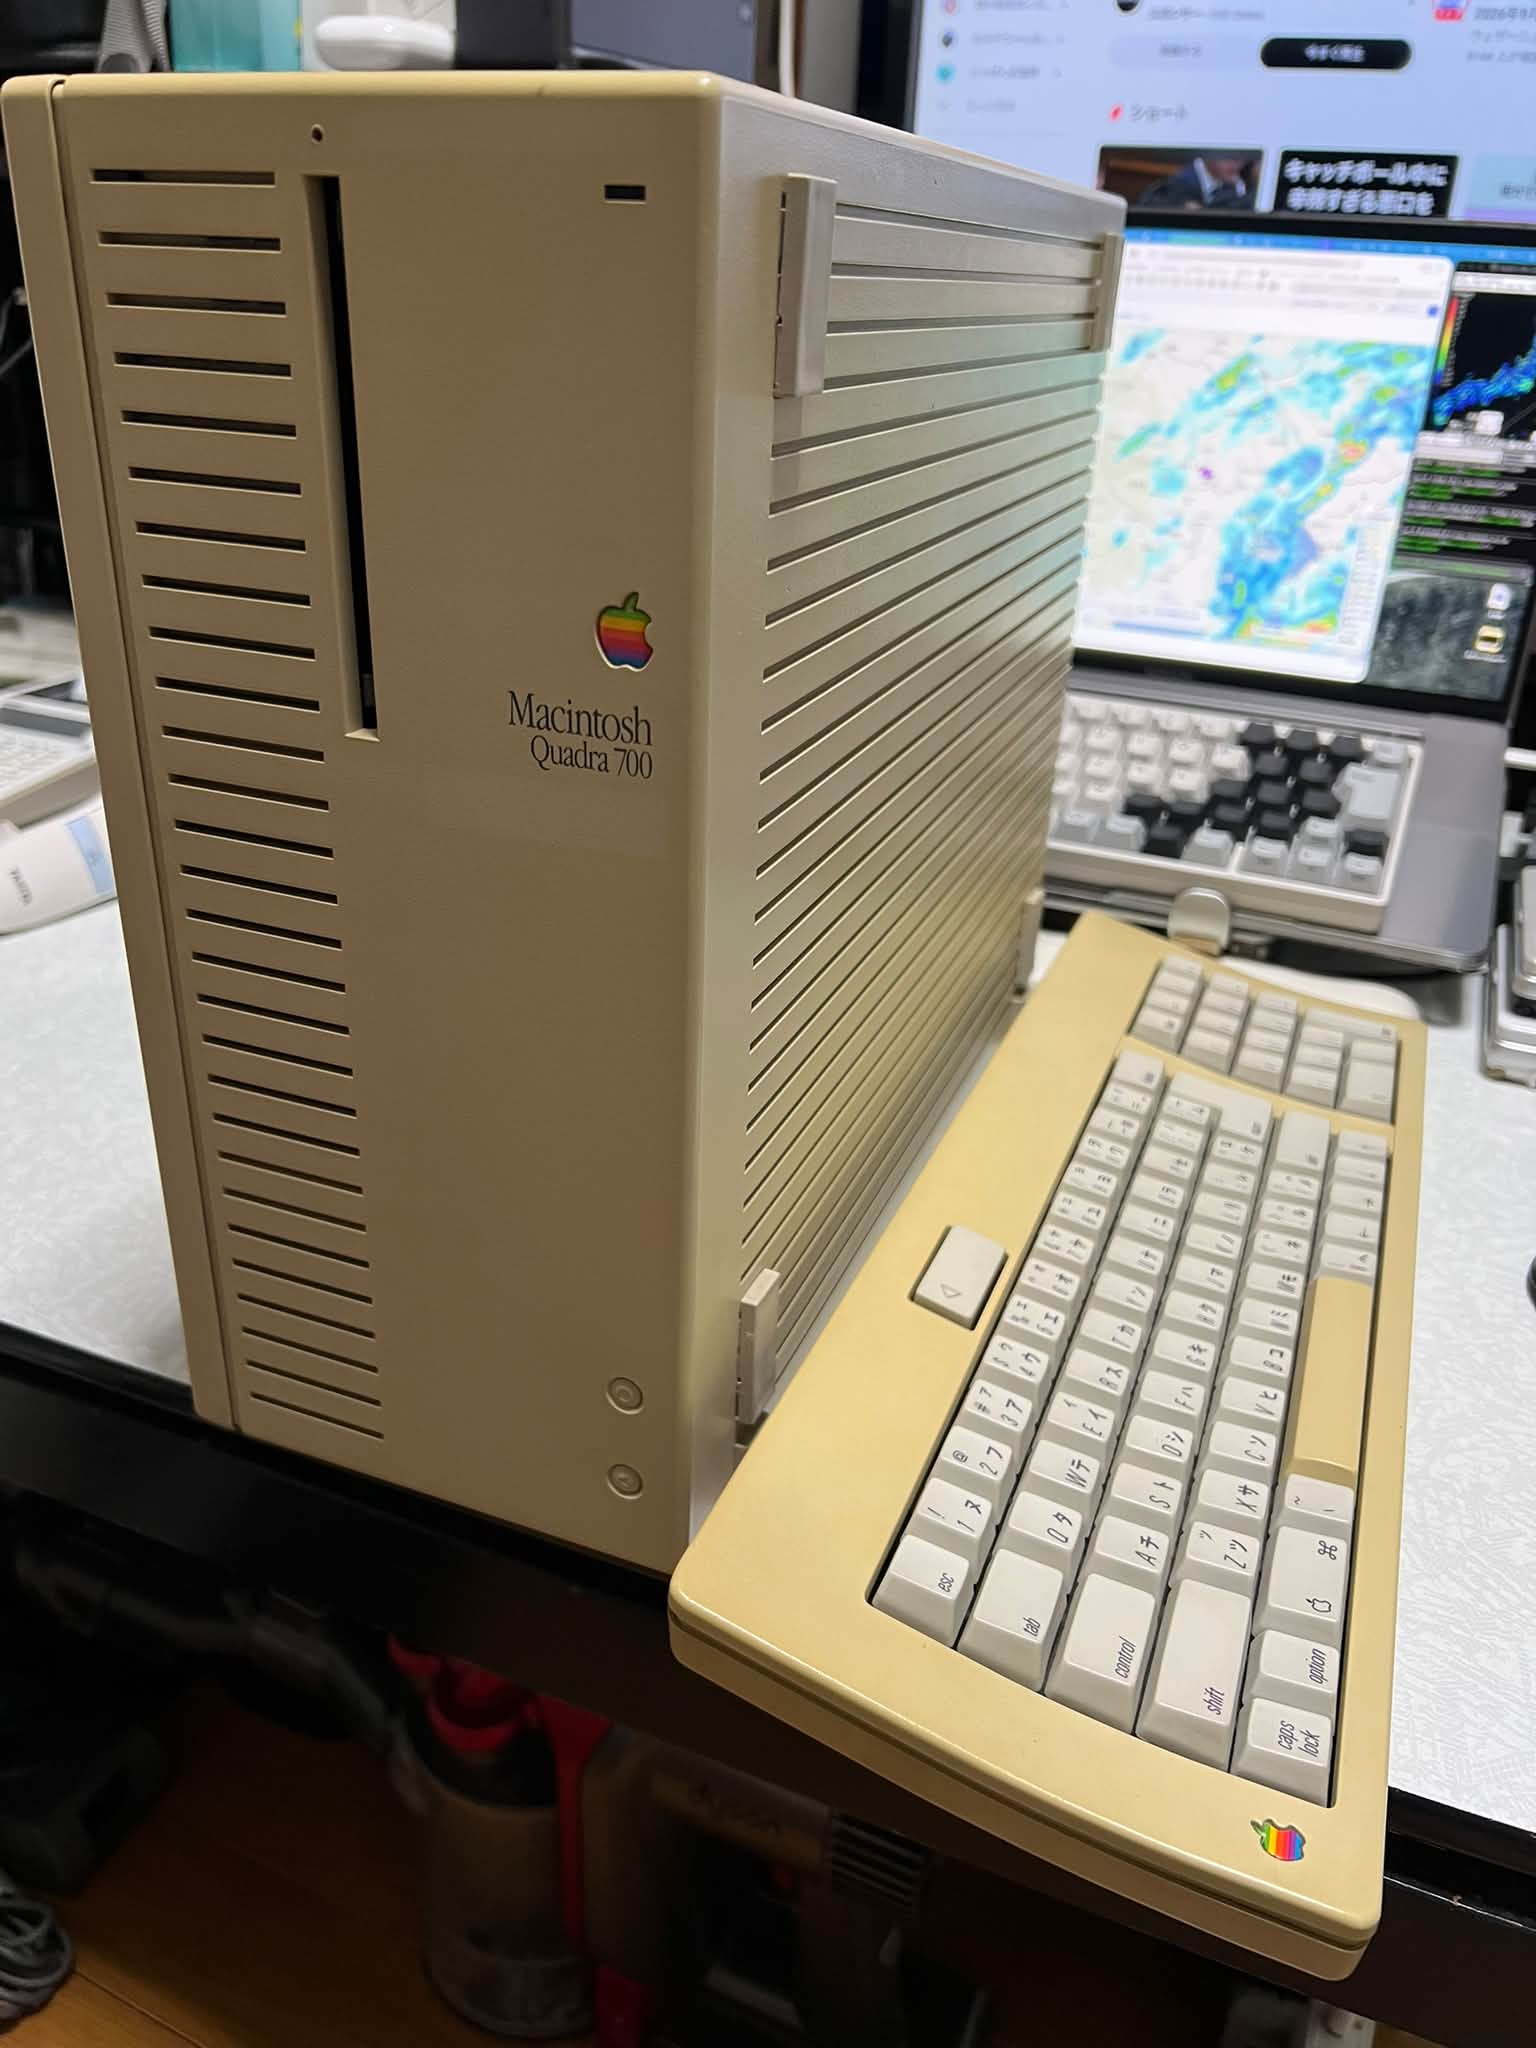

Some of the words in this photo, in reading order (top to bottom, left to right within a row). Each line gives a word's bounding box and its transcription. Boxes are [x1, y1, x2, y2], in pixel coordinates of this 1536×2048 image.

[508, 690, 652, 746] Macintosh
[530, 735, 610, 773] Quadra
[613, 747, 653, 780] 700
[1044, 1313, 1059, 1324] エ
[1269, 1349, 1284, 1358] コ
[1106, 1367, 1123, 1378] ス
[1181, 1387, 1193, 1398] ハ
[1259, 1391, 1277, 1400] ヒ
[1174, 1397, 1194, 1411] F
[1000, 1414, 1019, 1427] 3
[1088, 1409, 1107, 1420] イ
[1082, 1423, 1102, 1437] E
[1166, 1431, 1184, 1443] シ
[1244, 1450, 1266, 1461] C
[979, 1462, 998, 1476] 2
[1071, 1459, 1090, 1472] テ
[1065, 1467, 1087, 1488] W
[1153, 1482, 1174, 1491] ト
[1238, 1485, 1259, 1496] サ
[1149, 1495, 1171, 1509] S
[1236, 1498, 1257, 1513] X
[957, 1520, 975, 1532] 1
[1053, 1512, 1072, 1526] タ
[1140, 1536, 1159, 1550] チ
[1230, 1539, 1247, 1552] ツ
[1135, 1551, 1157, 1566] A
[1224, 1554, 1247, 1569] Z
[938, 1572, 954, 1593] esc
[1023, 1617, 1041, 1637] tab
[1115, 1636, 1136, 1679] control
[1305, 1648, 1328, 1684] option
[1202, 1687, 1224, 1715] shift
[1278, 1720, 1298, 1750] caps
[1297, 1730, 1320, 1758] lock
